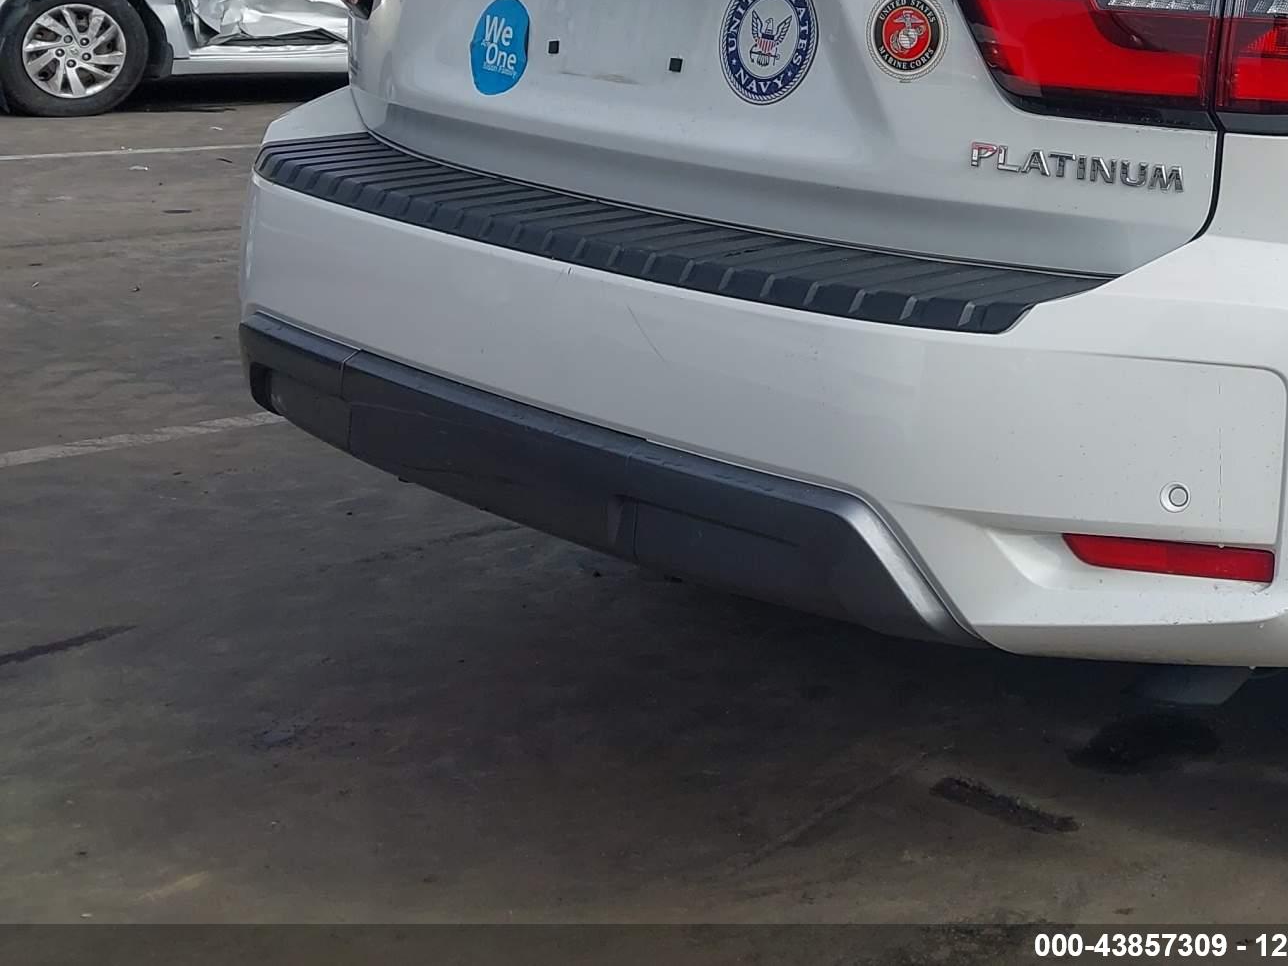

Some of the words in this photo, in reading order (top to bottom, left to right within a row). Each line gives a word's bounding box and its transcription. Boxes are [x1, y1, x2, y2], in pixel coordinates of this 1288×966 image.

[485, 14, 513, 46] We
[486, 43, 517, 71] One
[878, 46, 907, 69] MARINE
[910, 48, 934, 69] CORPS
[735, 68, 784, 93] NAVY
[970, 141, 1184, 193] PLATINUM
